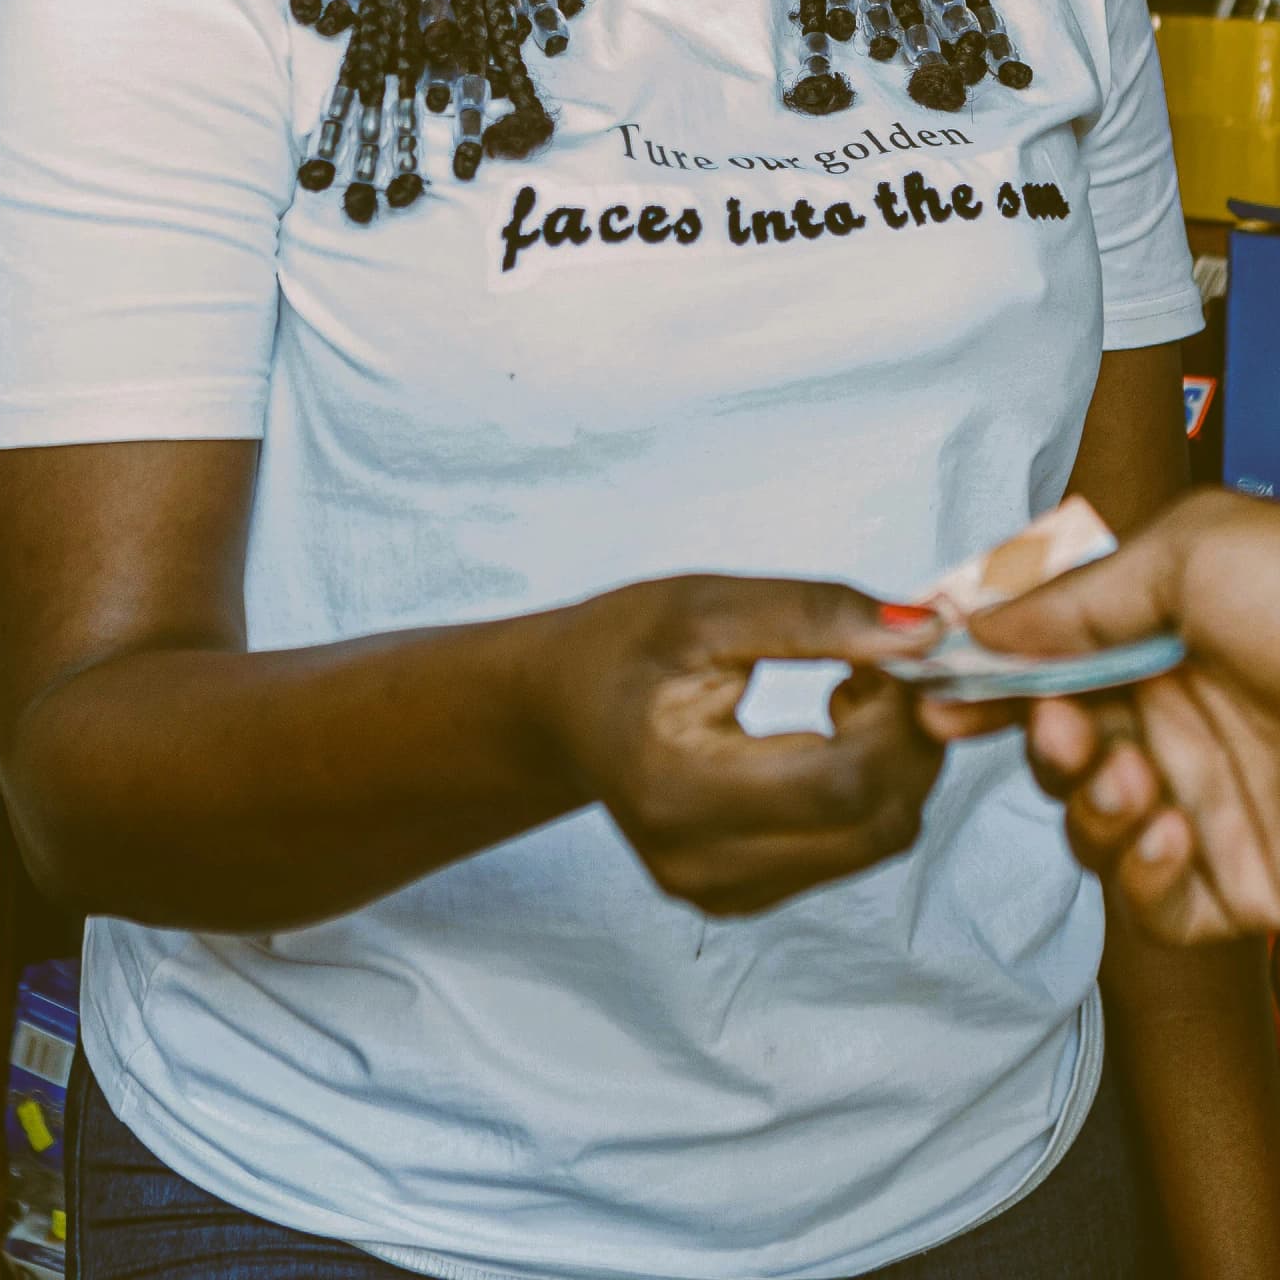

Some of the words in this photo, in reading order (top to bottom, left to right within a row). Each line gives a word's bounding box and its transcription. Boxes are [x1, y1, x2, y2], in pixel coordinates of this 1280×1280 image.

[814, 121, 974, 175] golden
[501, 185, 702, 273] faces
[726, 196, 866, 246] into
[874, 170, 983, 230] the
